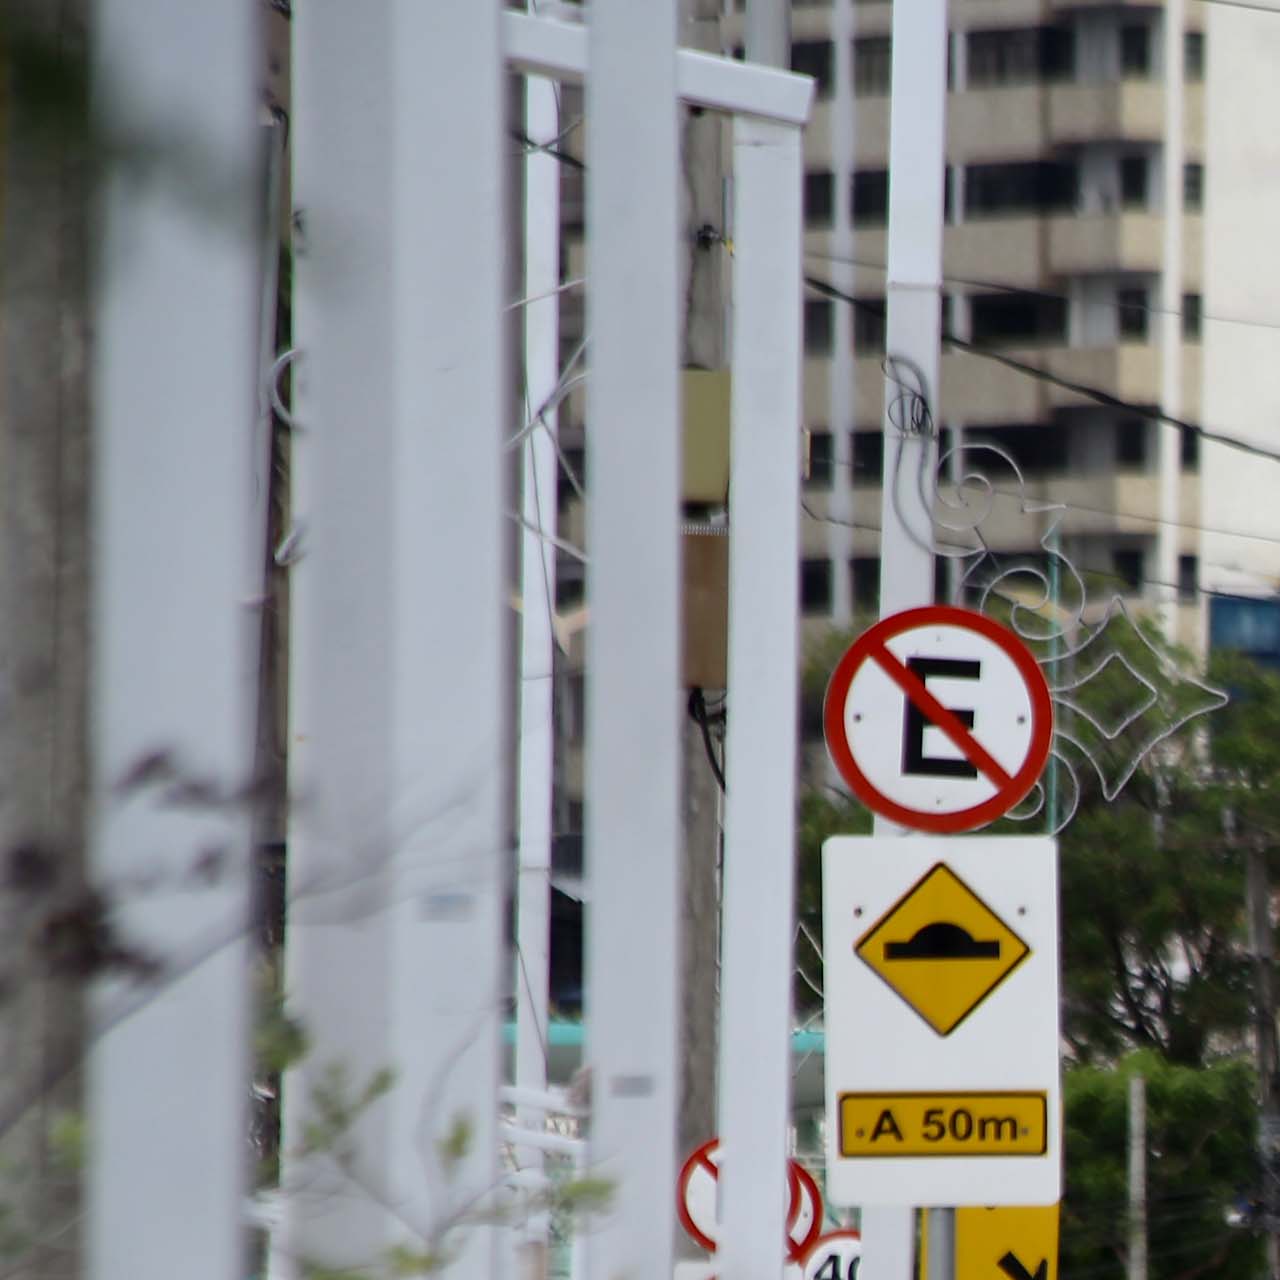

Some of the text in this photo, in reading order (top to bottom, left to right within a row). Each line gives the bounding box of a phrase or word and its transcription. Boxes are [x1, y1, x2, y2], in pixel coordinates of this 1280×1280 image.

[902, 657, 981, 778] E
[870, 1107, 1018, 1143] A 50m
